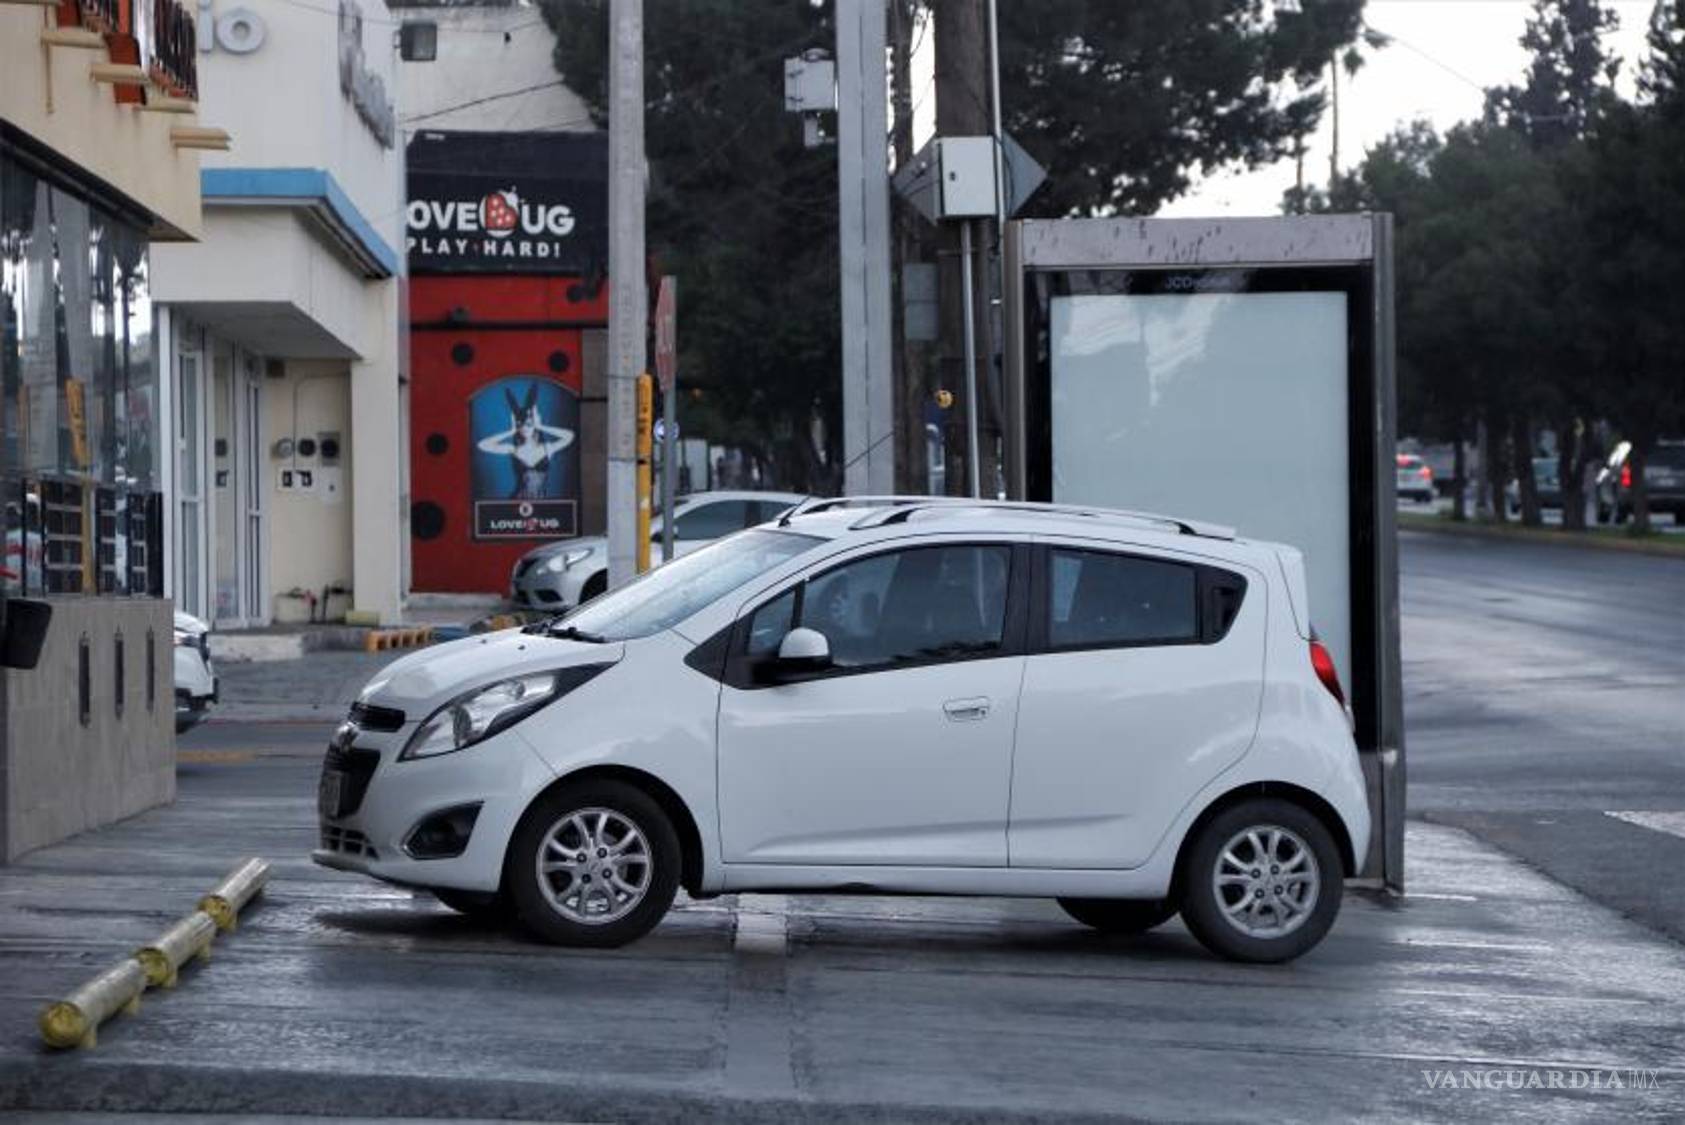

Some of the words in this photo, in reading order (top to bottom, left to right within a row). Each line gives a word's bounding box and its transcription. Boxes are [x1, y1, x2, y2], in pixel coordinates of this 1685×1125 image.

[406, 190, 575, 238] OVEBUG
[406, 237, 468, 254] PLAY
[483, 240, 561, 258] HARD!
